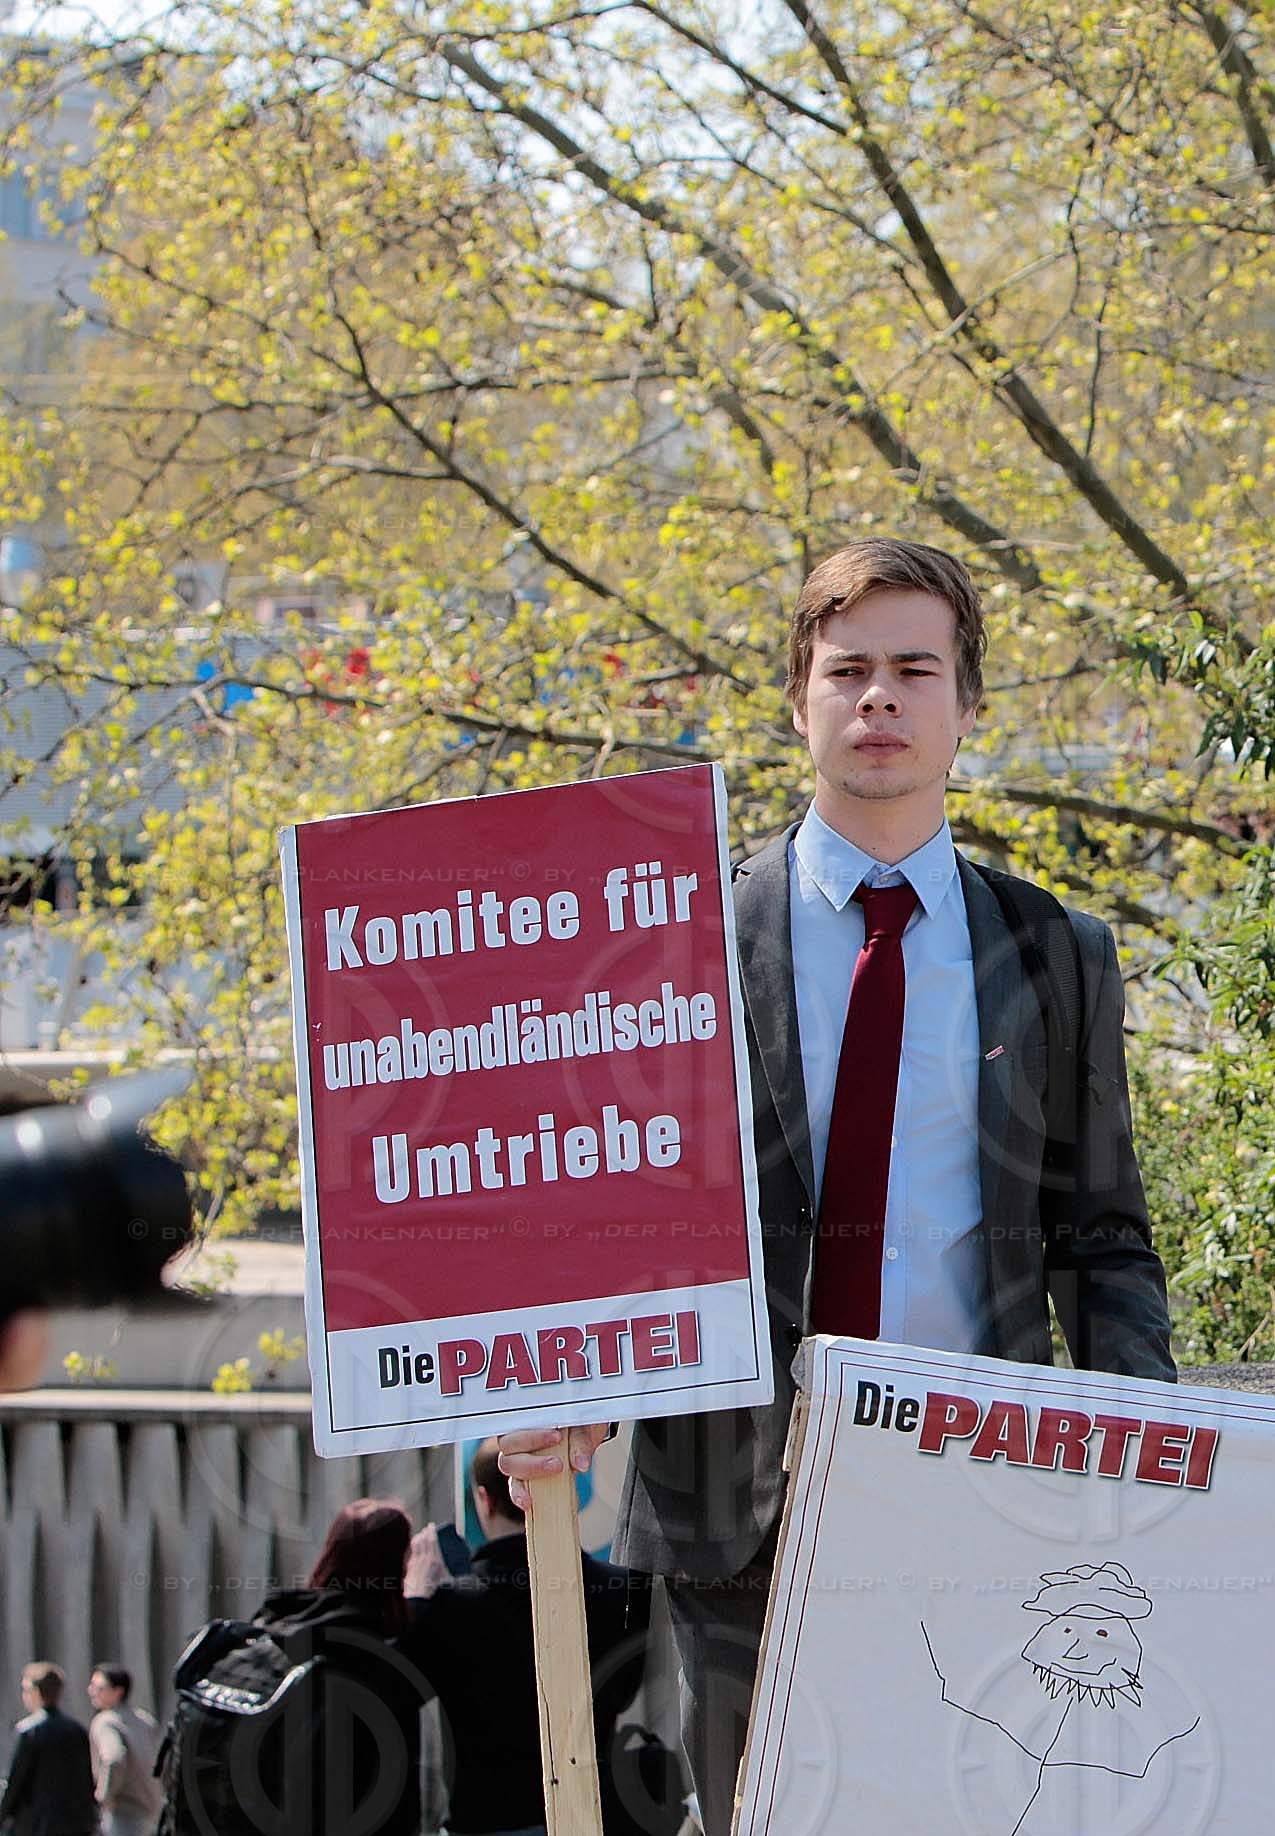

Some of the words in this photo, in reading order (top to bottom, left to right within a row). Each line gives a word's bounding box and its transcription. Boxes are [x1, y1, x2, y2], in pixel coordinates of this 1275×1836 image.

[325, 889, 580, 971] Komitee
[604, 860, 699, 931] für
[323, 982, 717, 1090] unabendländische
[371, 1104, 682, 1204] Umtriebe
[378, 1343, 434, 1389] Die
[437, 1310, 702, 1396] PARTEI
[853, 1380, 920, 1433] Die
[916, 1390, 1221, 1491] PARTEI
